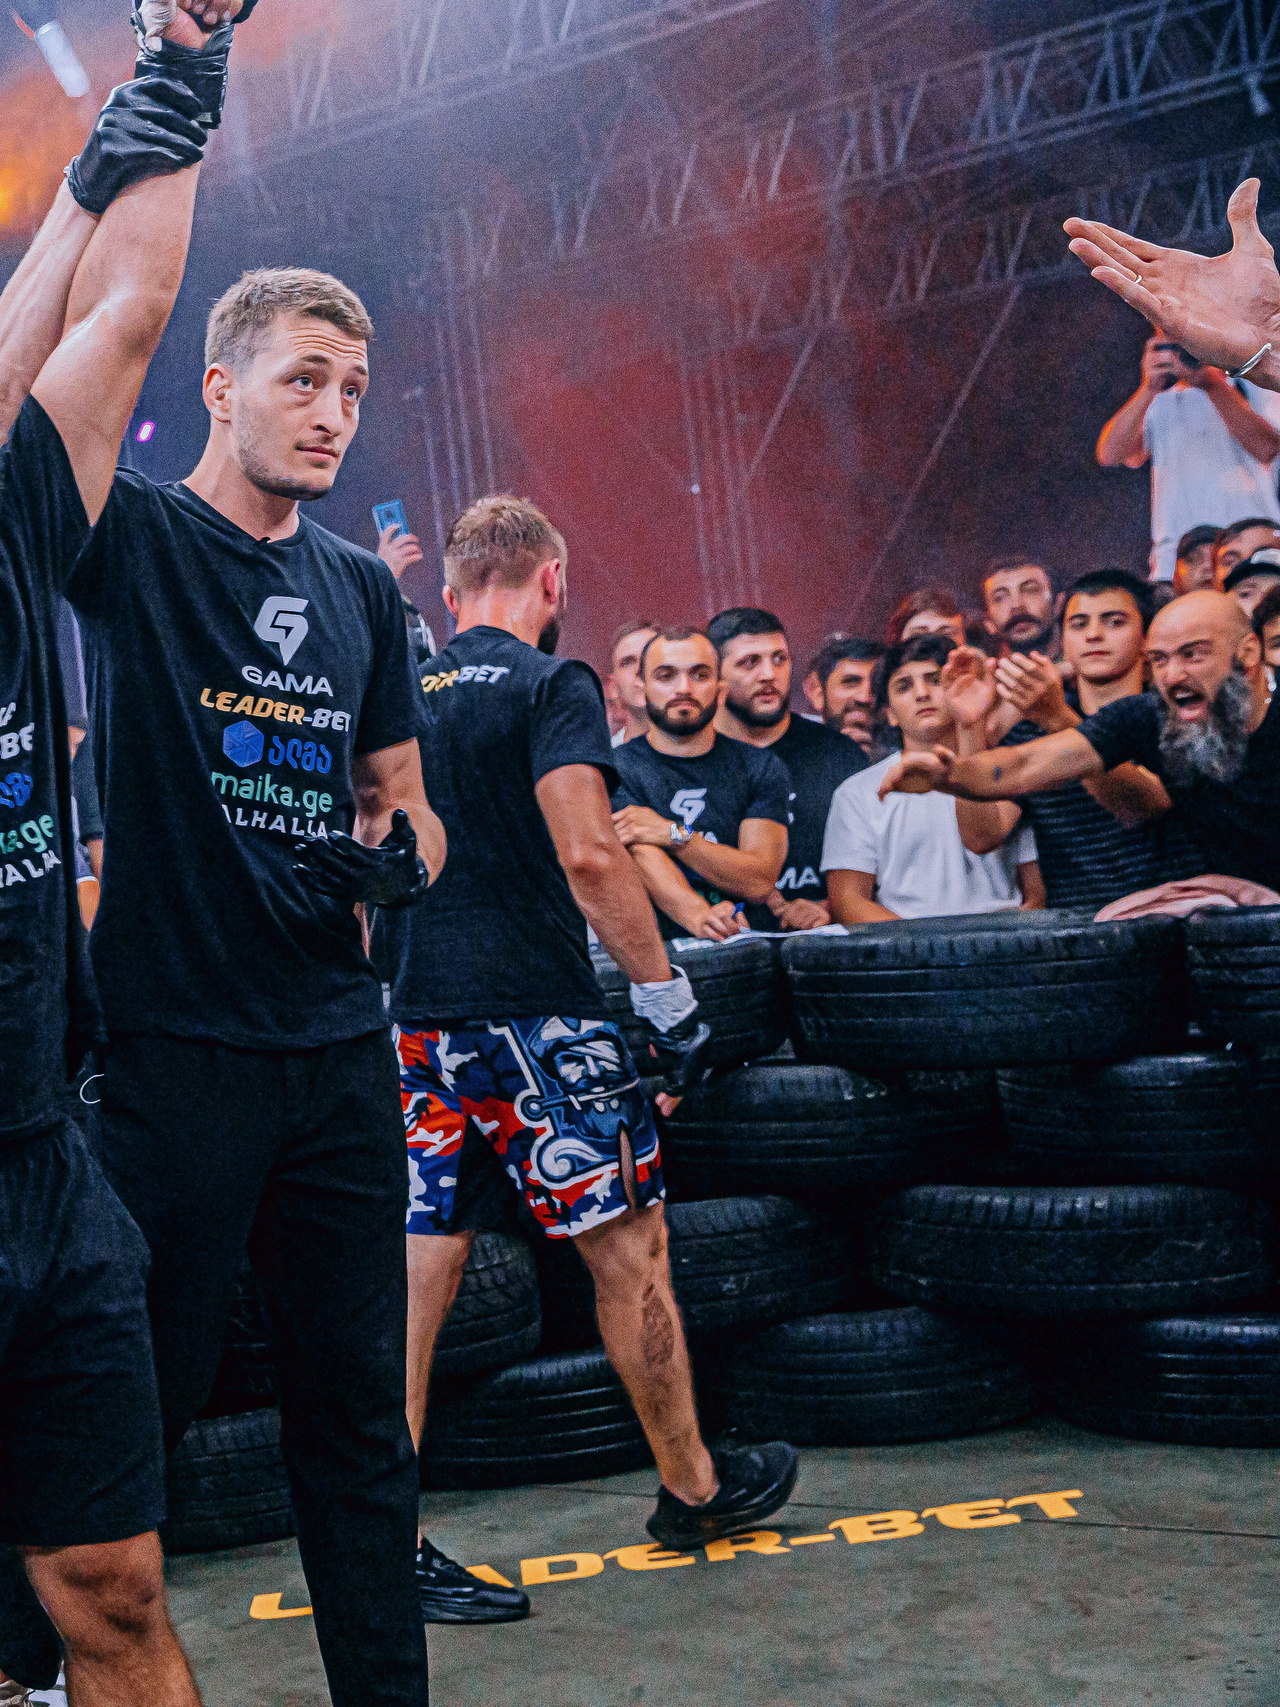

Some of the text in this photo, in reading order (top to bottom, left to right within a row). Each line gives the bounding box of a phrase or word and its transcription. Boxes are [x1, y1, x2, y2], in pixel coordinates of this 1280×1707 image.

[241, 665, 334, 698] GAMA
[199, 687, 352, 733] LEADER-BET
[211, 770, 333, 818] maika.ge
[221, 803, 329, 841] LHALLA
[249, 1489, 1084, 1620] LDER-BET
